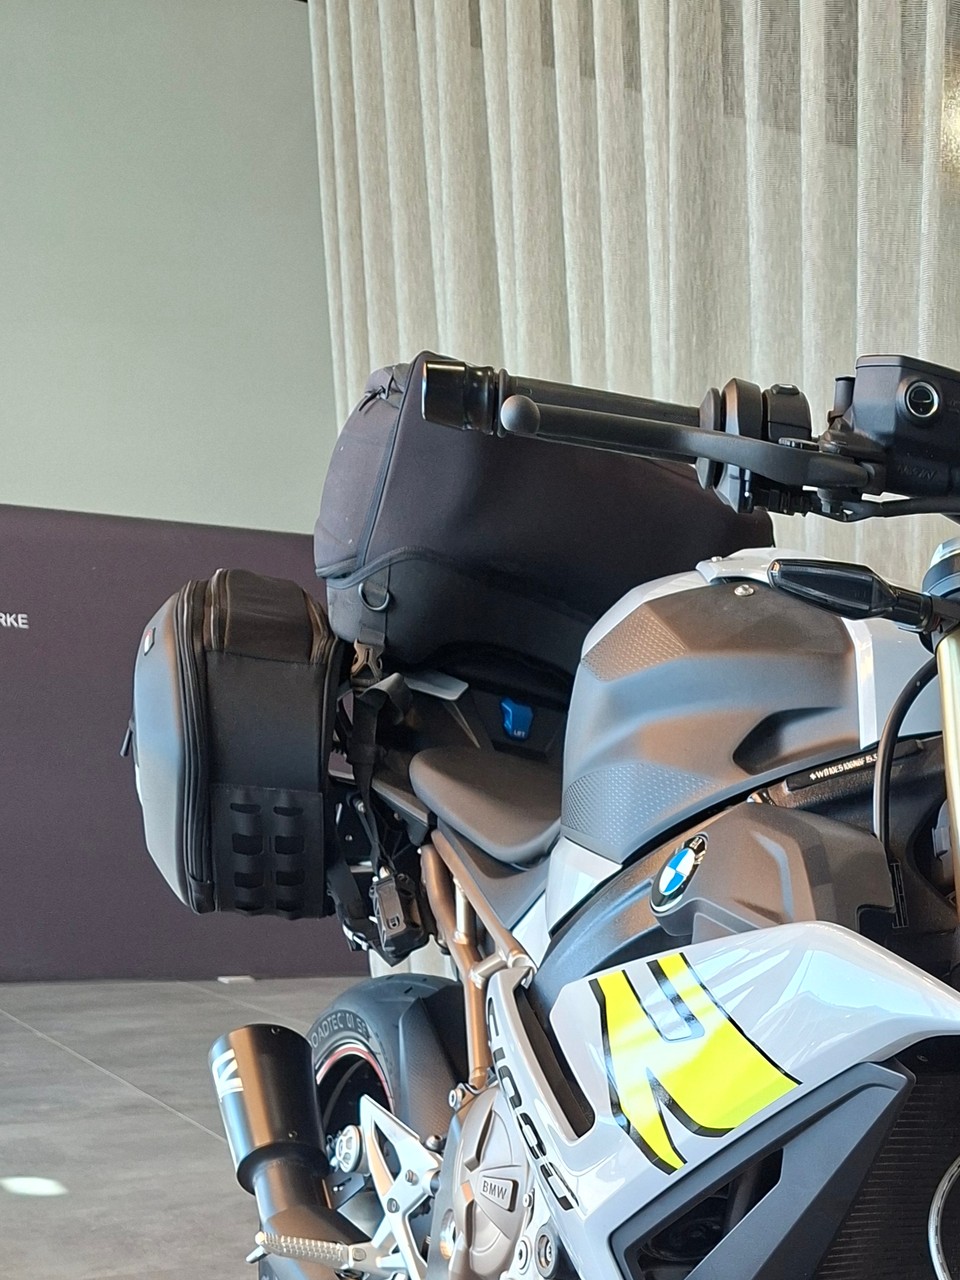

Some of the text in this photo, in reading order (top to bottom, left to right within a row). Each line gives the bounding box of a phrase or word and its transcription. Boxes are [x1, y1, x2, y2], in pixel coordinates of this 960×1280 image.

[0, 613, 29, 629] RKE
[311, 1012, 344, 1048] OADTEC
[482, 1180, 507, 1200] BMW
